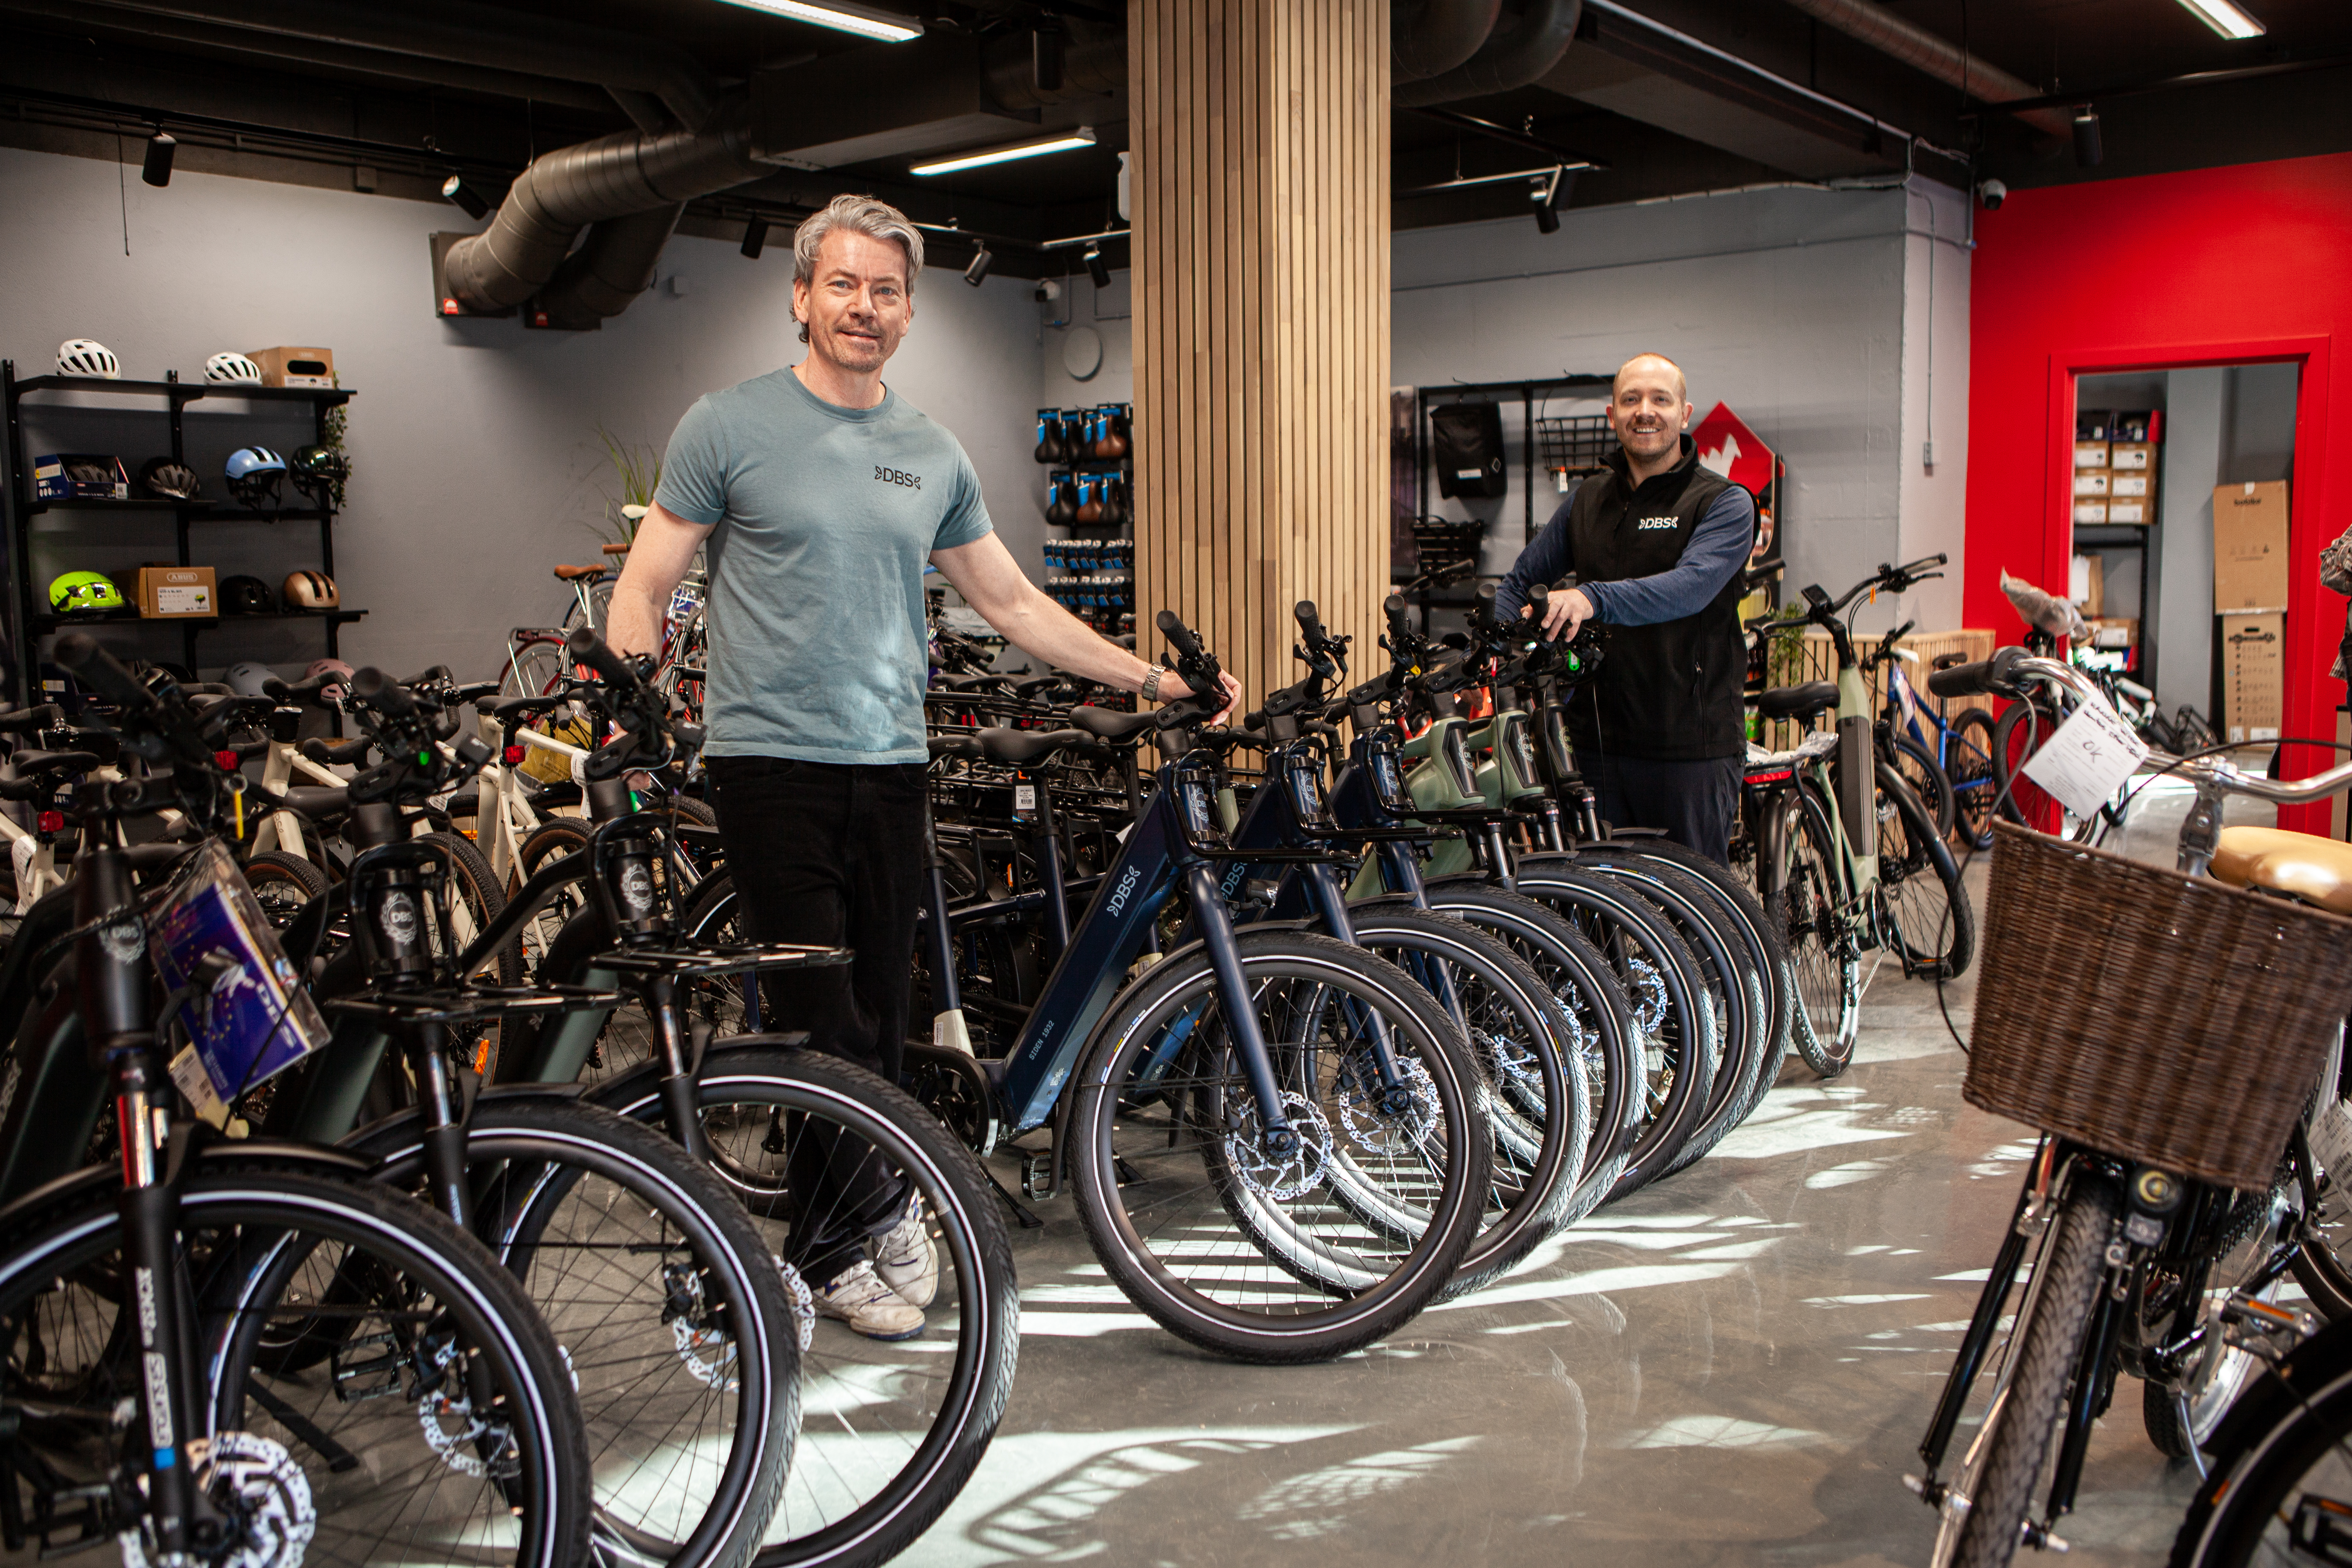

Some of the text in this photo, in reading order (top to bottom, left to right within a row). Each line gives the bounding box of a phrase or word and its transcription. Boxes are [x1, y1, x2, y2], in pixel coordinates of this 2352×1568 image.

[883, 467, 913, 487] DBS
[1645, 517, 1672, 530] DBS
[631, 881, 649, 891] DBS
[1220, 862, 1245, 896] DBS
[1110, 874, 1136, 910] DBS
[391, 911, 413, 923] DBS
[111, 926, 139, 939] DBS
[1029, 1020, 1054, 1060] SIDEN 1932
